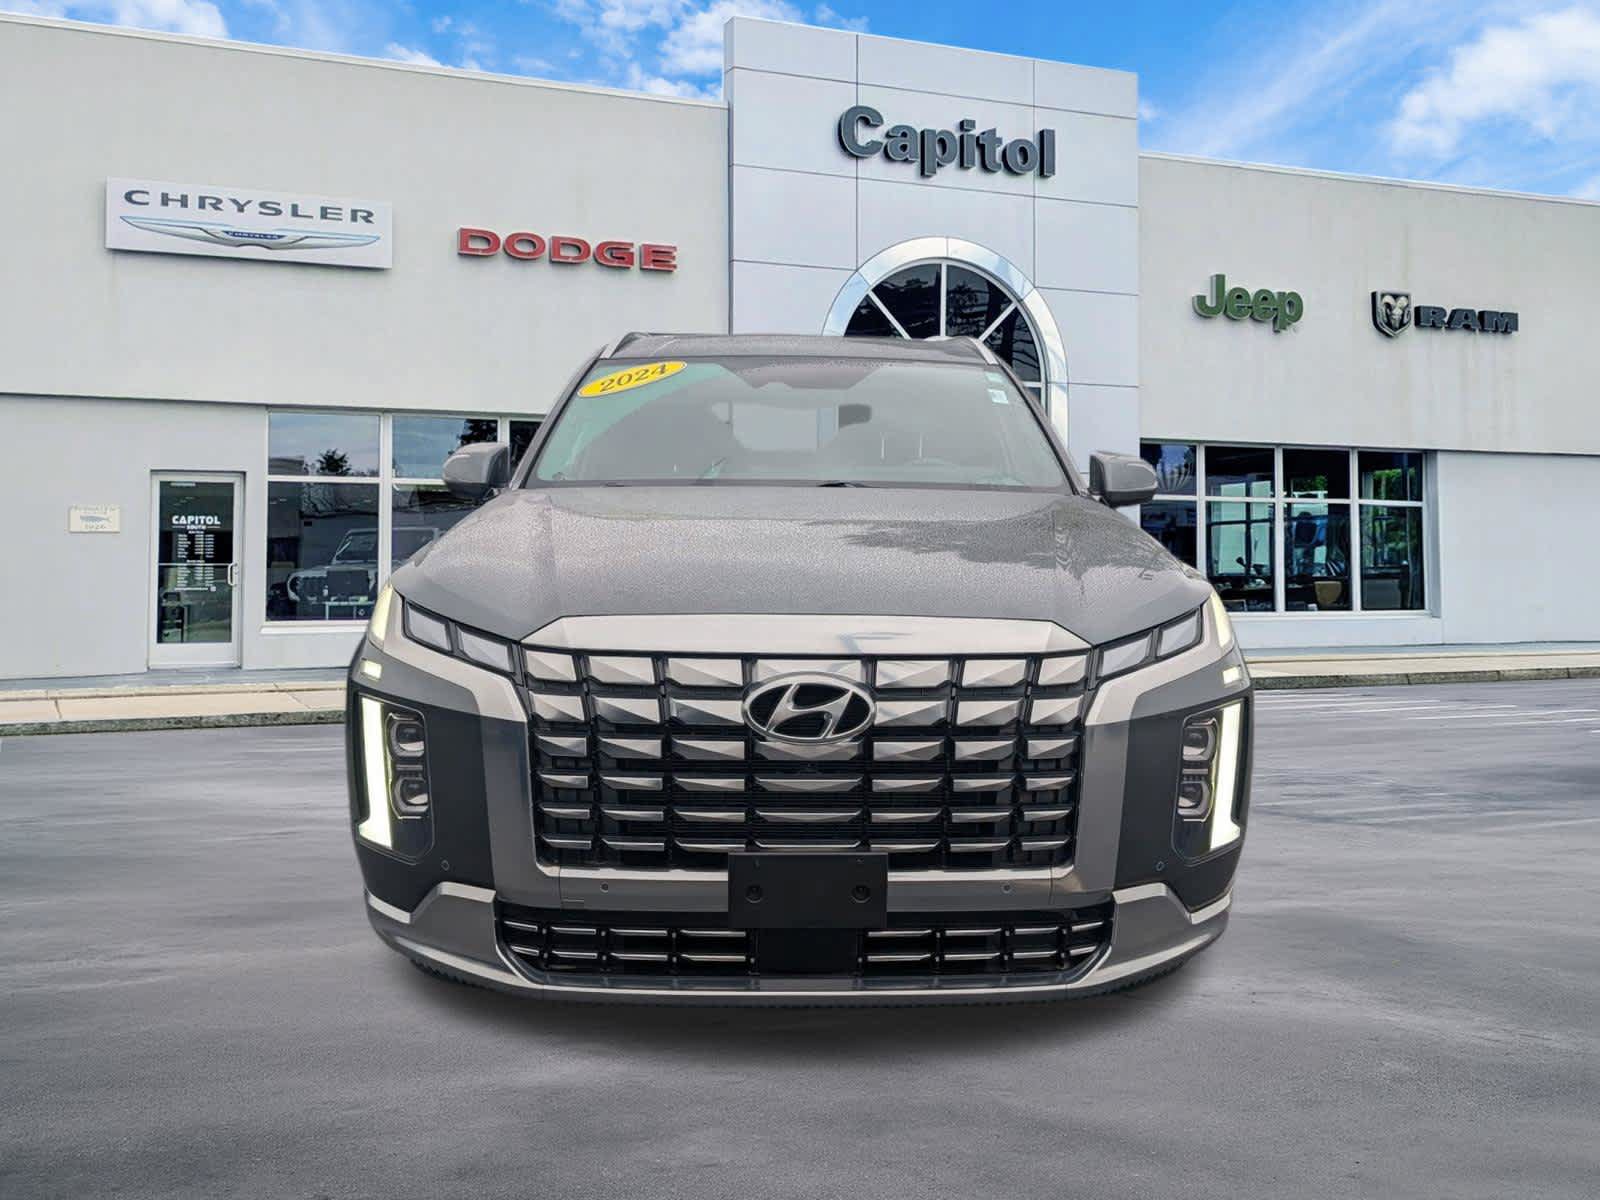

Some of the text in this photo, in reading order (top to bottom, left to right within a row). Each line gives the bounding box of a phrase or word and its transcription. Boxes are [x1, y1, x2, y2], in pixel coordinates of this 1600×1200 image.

[838, 105, 1056, 177] Capitol
[123, 189, 375, 224] CHRYSLER
[457, 227, 678, 272] DODGE
[1192, 274, 1304, 333] Jeep
[1414, 305, 1519, 334] RAM
[599, 364, 669, 393] 2024
[171, 514, 221, 525] CAPITOL
